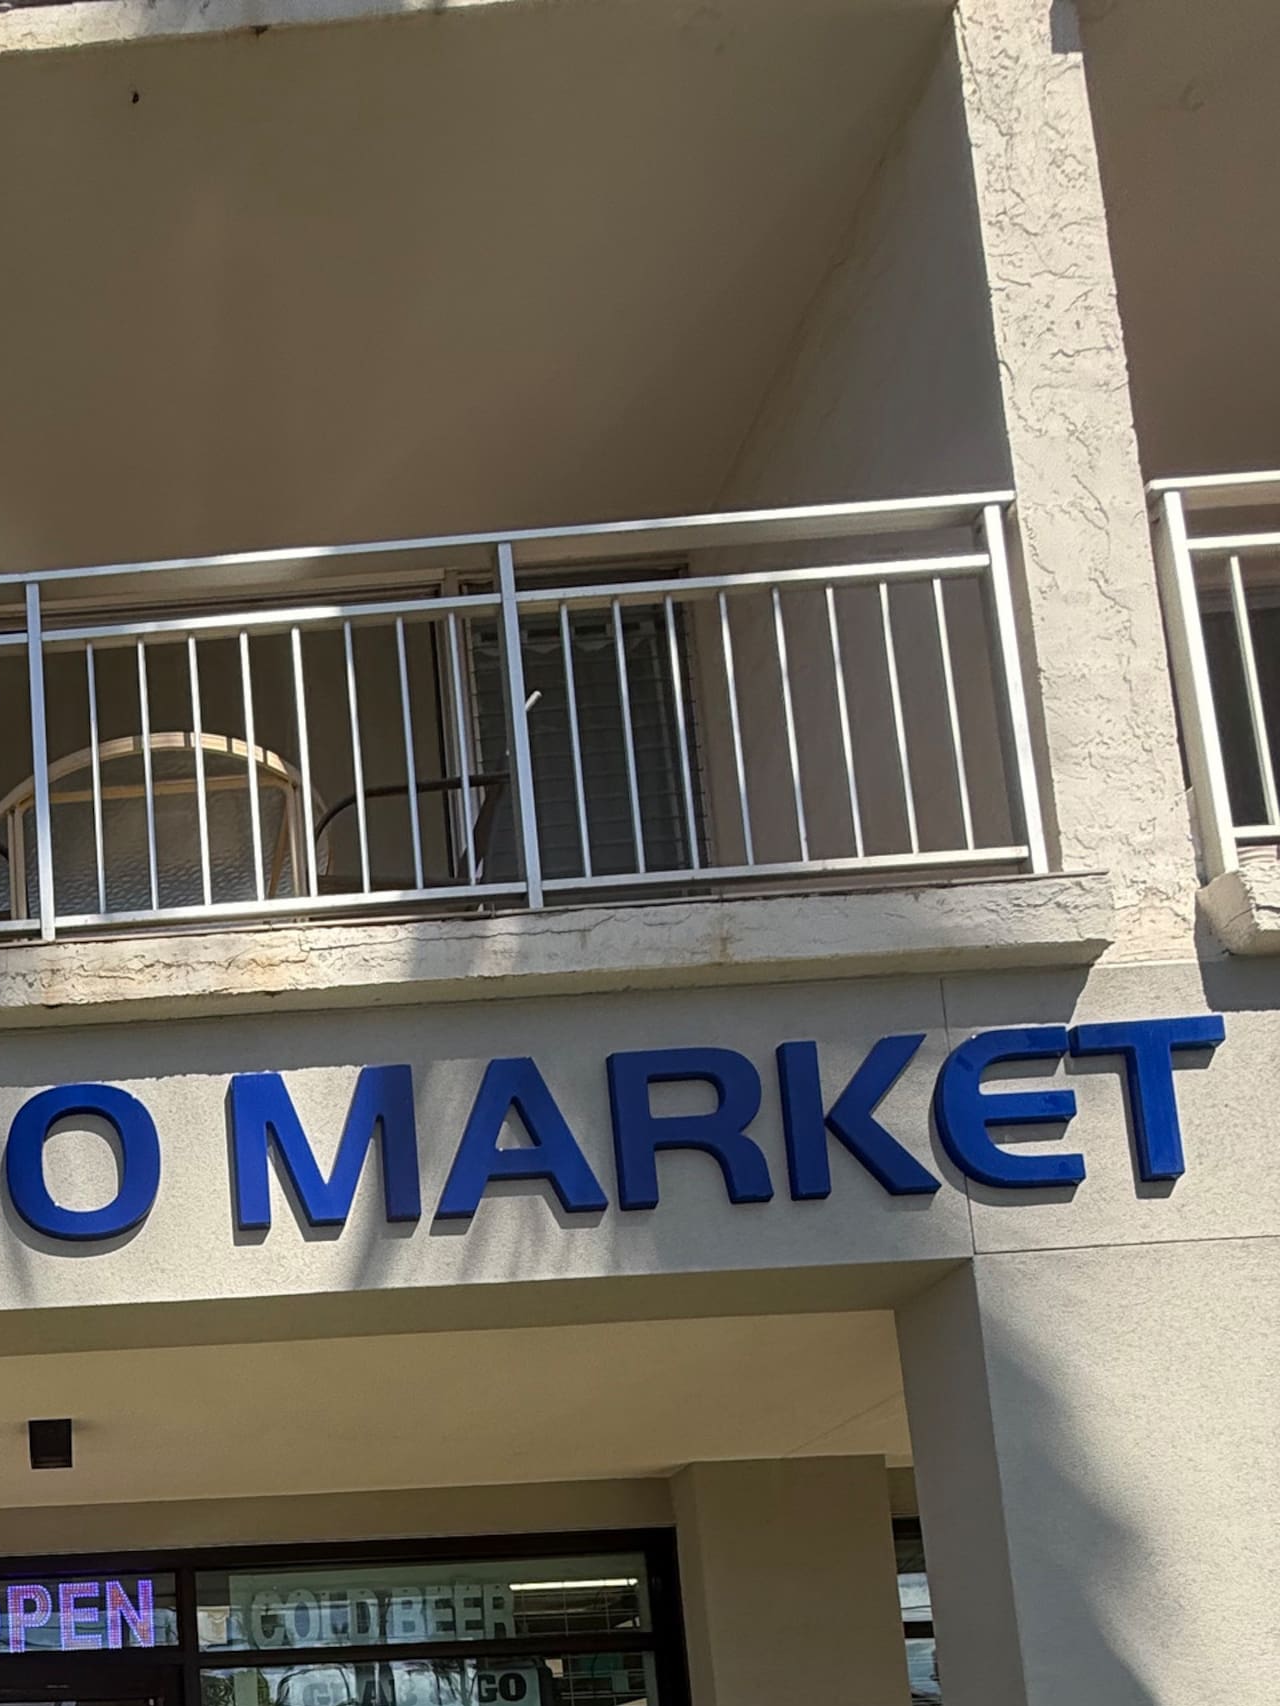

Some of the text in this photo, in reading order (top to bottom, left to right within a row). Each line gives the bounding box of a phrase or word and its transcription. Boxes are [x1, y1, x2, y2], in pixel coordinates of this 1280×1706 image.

[225, 1015, 1225, 1232] MARKET
[252, 1584, 514, 1649] COLD BEER
[477, 1672, 527, 1703] GO
